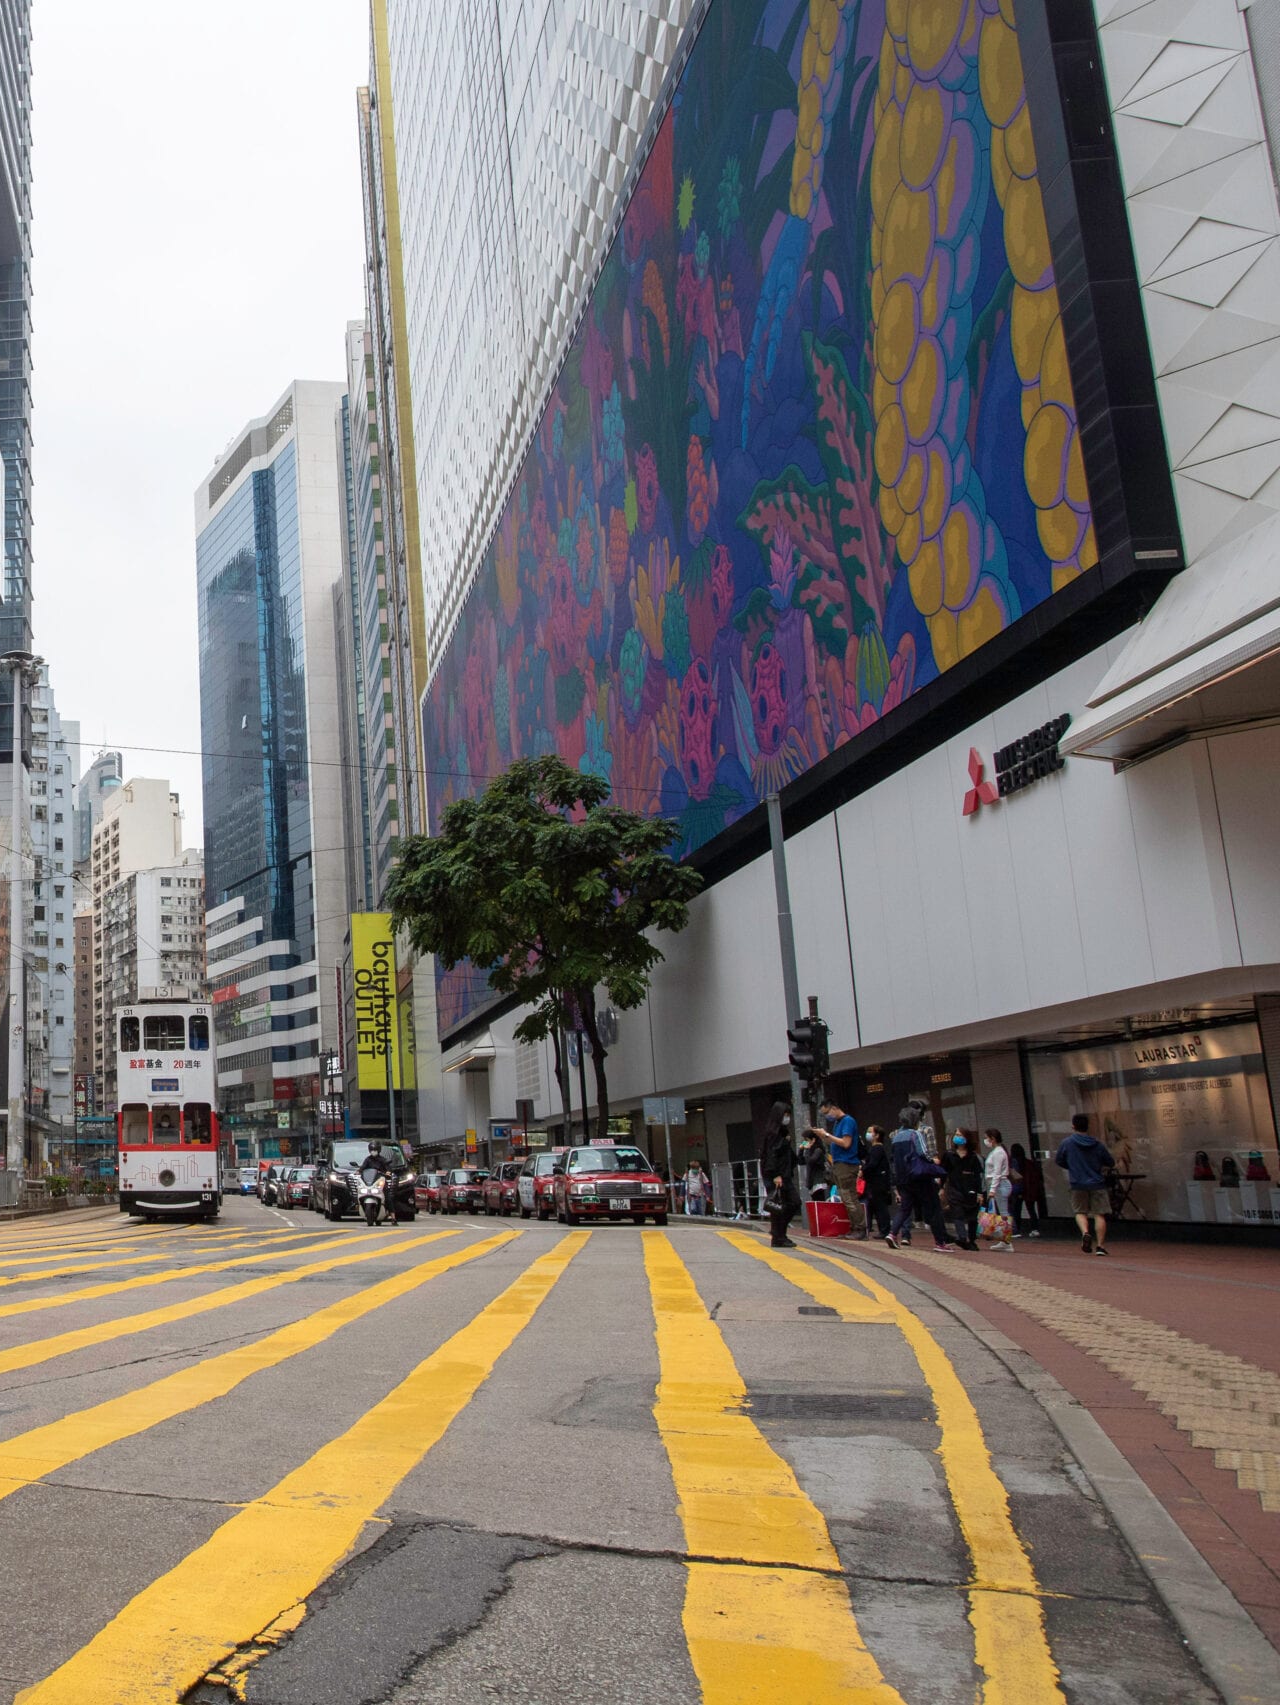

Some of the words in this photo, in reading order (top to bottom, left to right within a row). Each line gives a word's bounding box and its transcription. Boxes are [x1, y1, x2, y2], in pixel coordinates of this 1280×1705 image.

[155, 987, 173, 997] 131
[355, 969, 376, 1060] OUTLET
[1135, 1044, 1198, 1063] LAURASTAR
